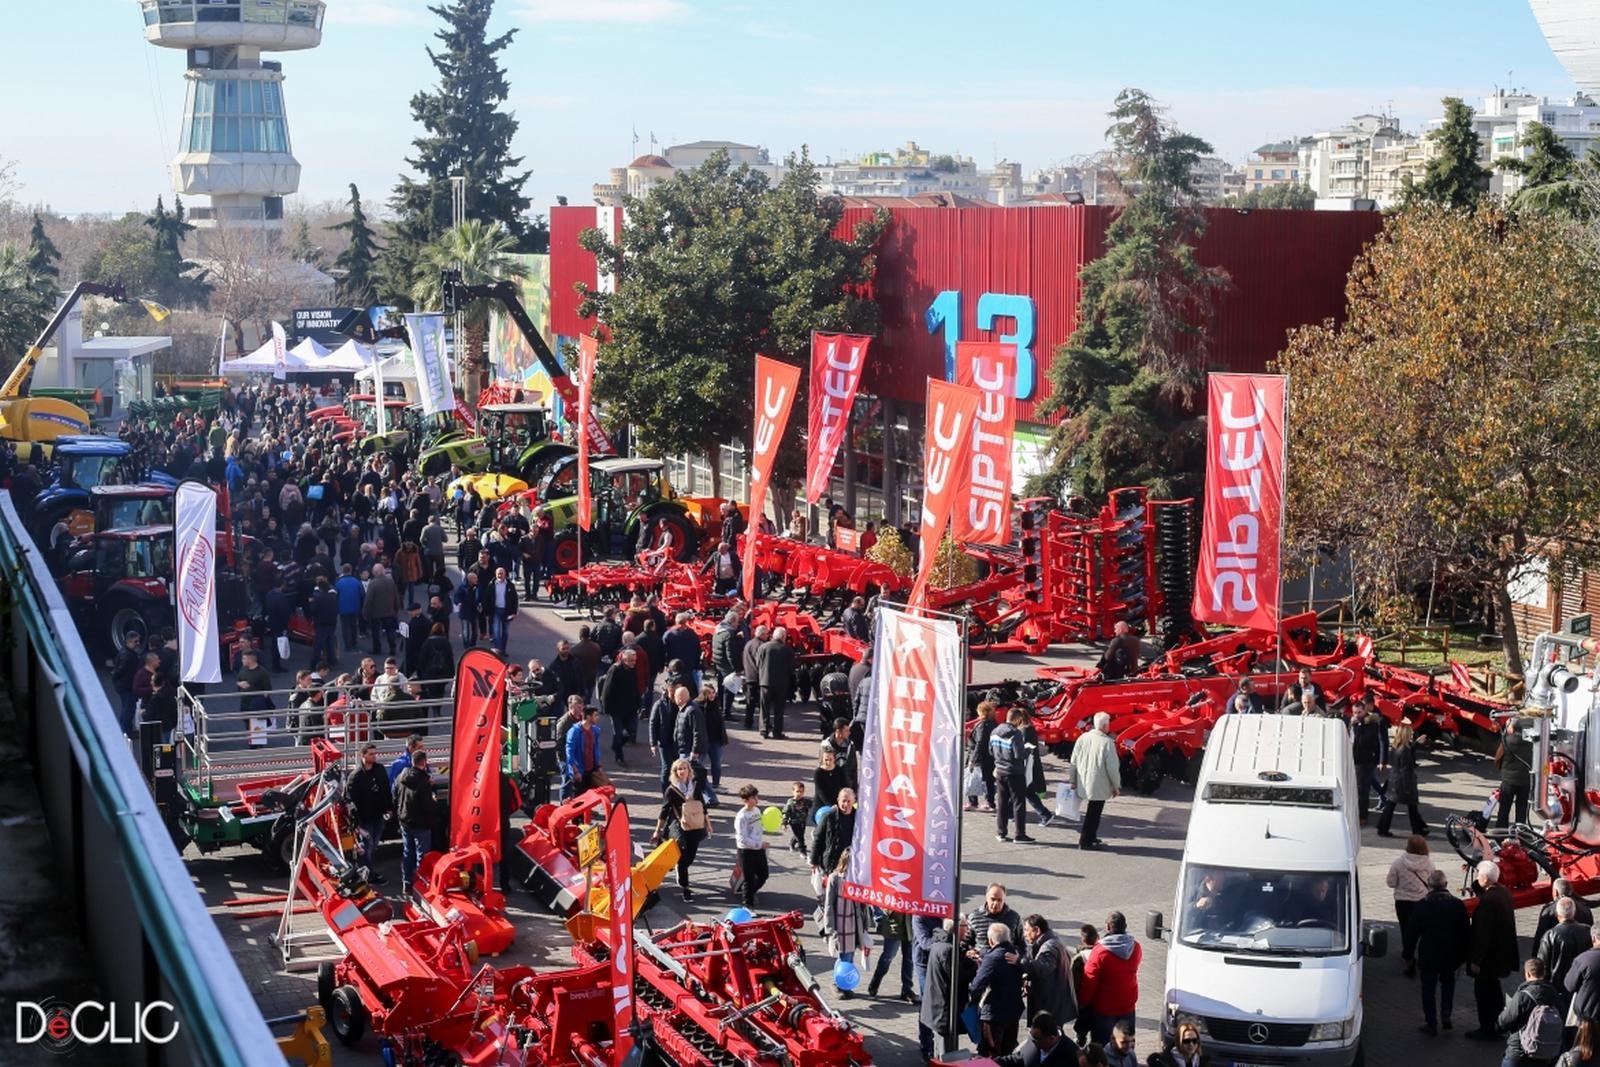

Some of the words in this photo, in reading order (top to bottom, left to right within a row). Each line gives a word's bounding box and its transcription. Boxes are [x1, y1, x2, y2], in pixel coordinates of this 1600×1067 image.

[296, 311, 310, 319] OUR
[311, 310, 332, 319] VISION
[296, 320, 305, 328] OF
